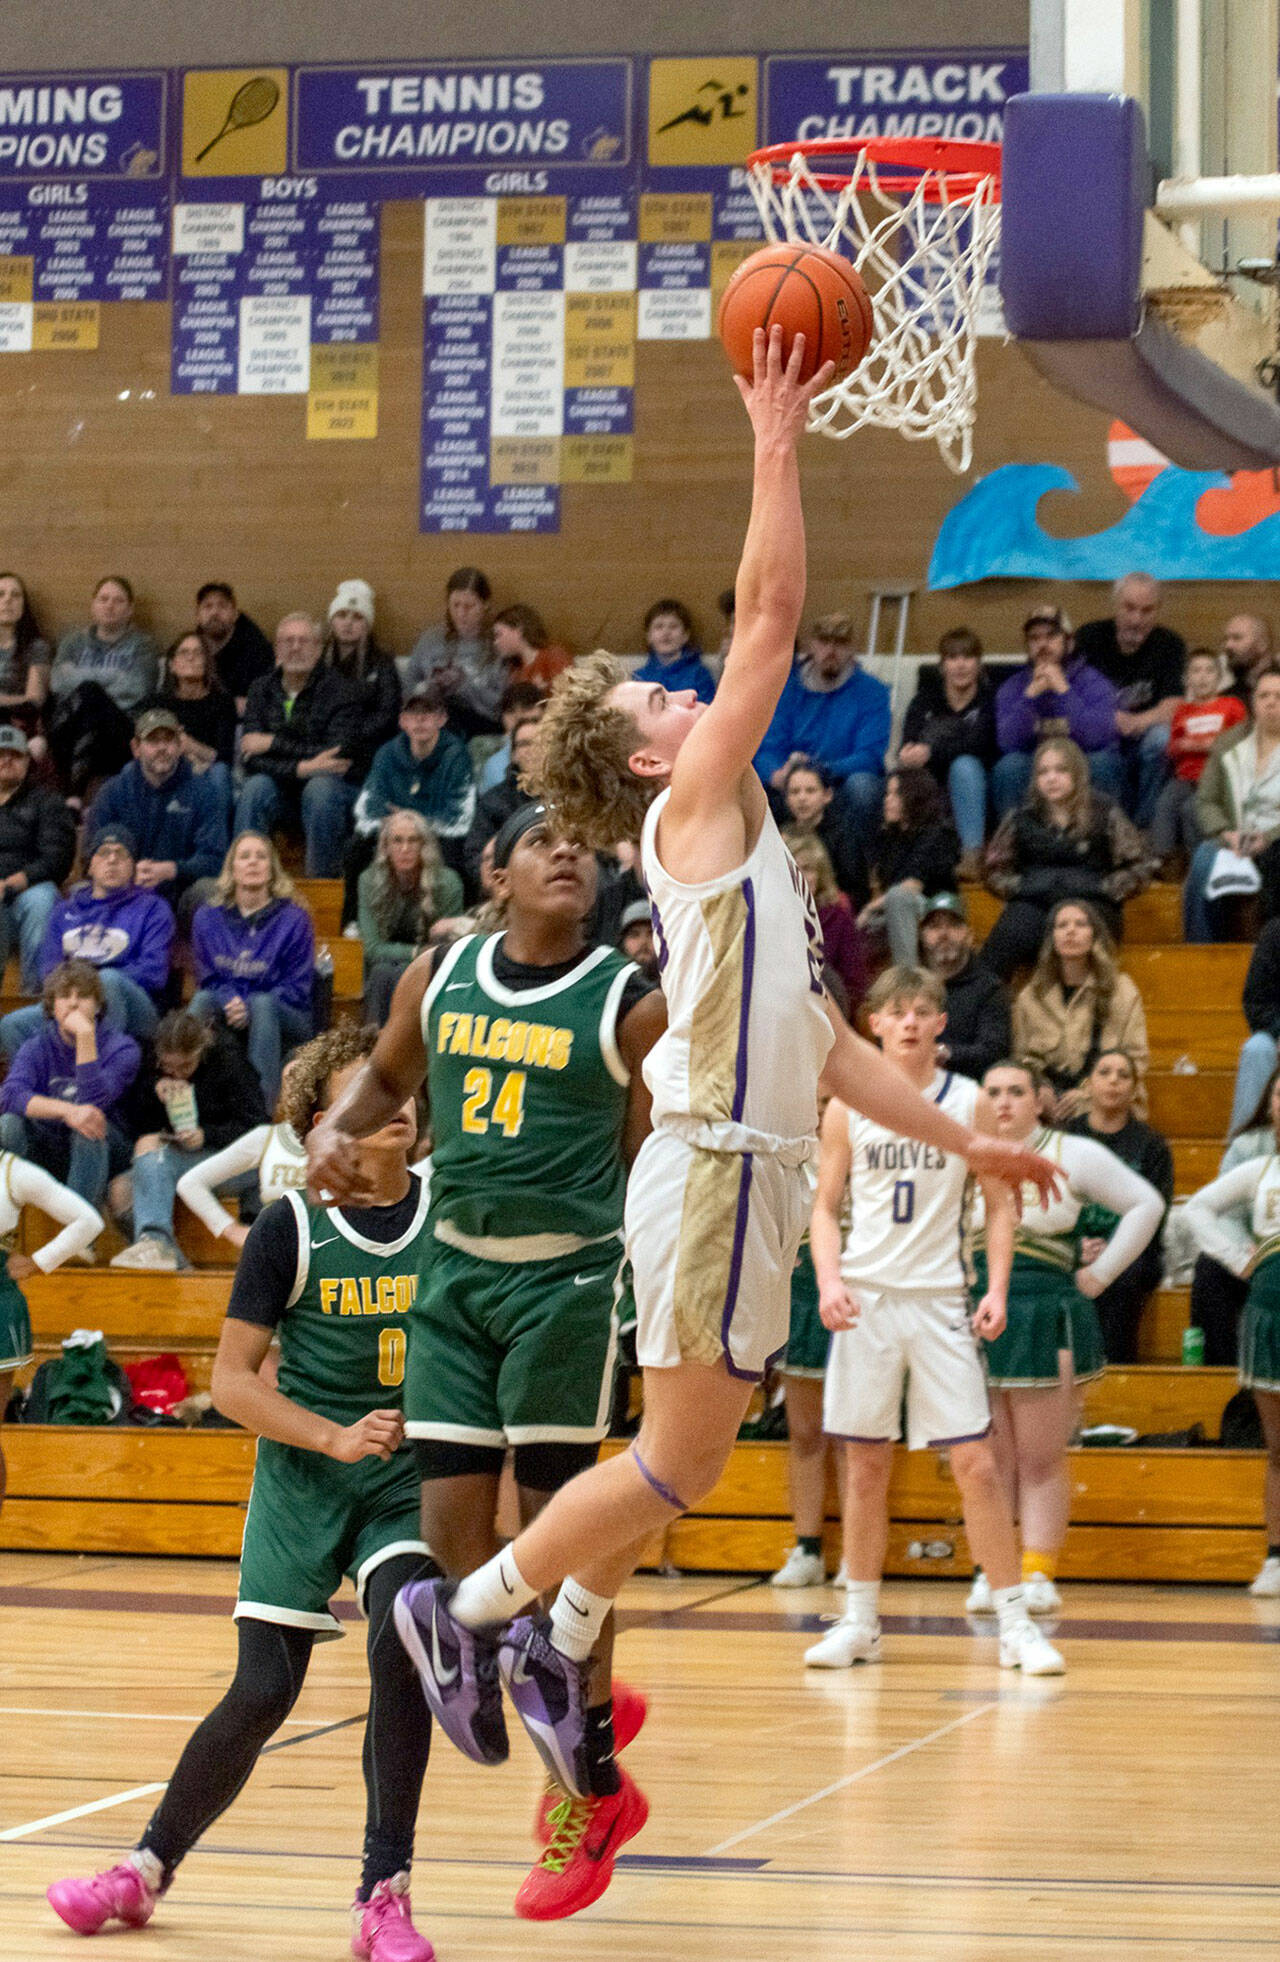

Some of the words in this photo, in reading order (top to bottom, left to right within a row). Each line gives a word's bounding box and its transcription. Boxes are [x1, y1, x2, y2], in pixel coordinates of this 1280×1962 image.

[357, 73, 545, 115] TENNIS
[827, 63, 1007, 104] TRACK
[0, 87, 123, 124] MING
[0, 133, 109, 168] PIONS
[335, 118, 571, 159] CHAMPIONS
[28, 182, 88, 205] GIRLS
[261, 176, 318, 199] BOYS
[485, 171, 549, 193] GIRLS
[436, 1010, 575, 1071] FALCONS
[461, 1065, 527, 1138] 24
[864, 1142, 947, 1170] WOLVES
[892, 1180, 915, 1225] 0
[377, 1327, 407, 1386] 0
